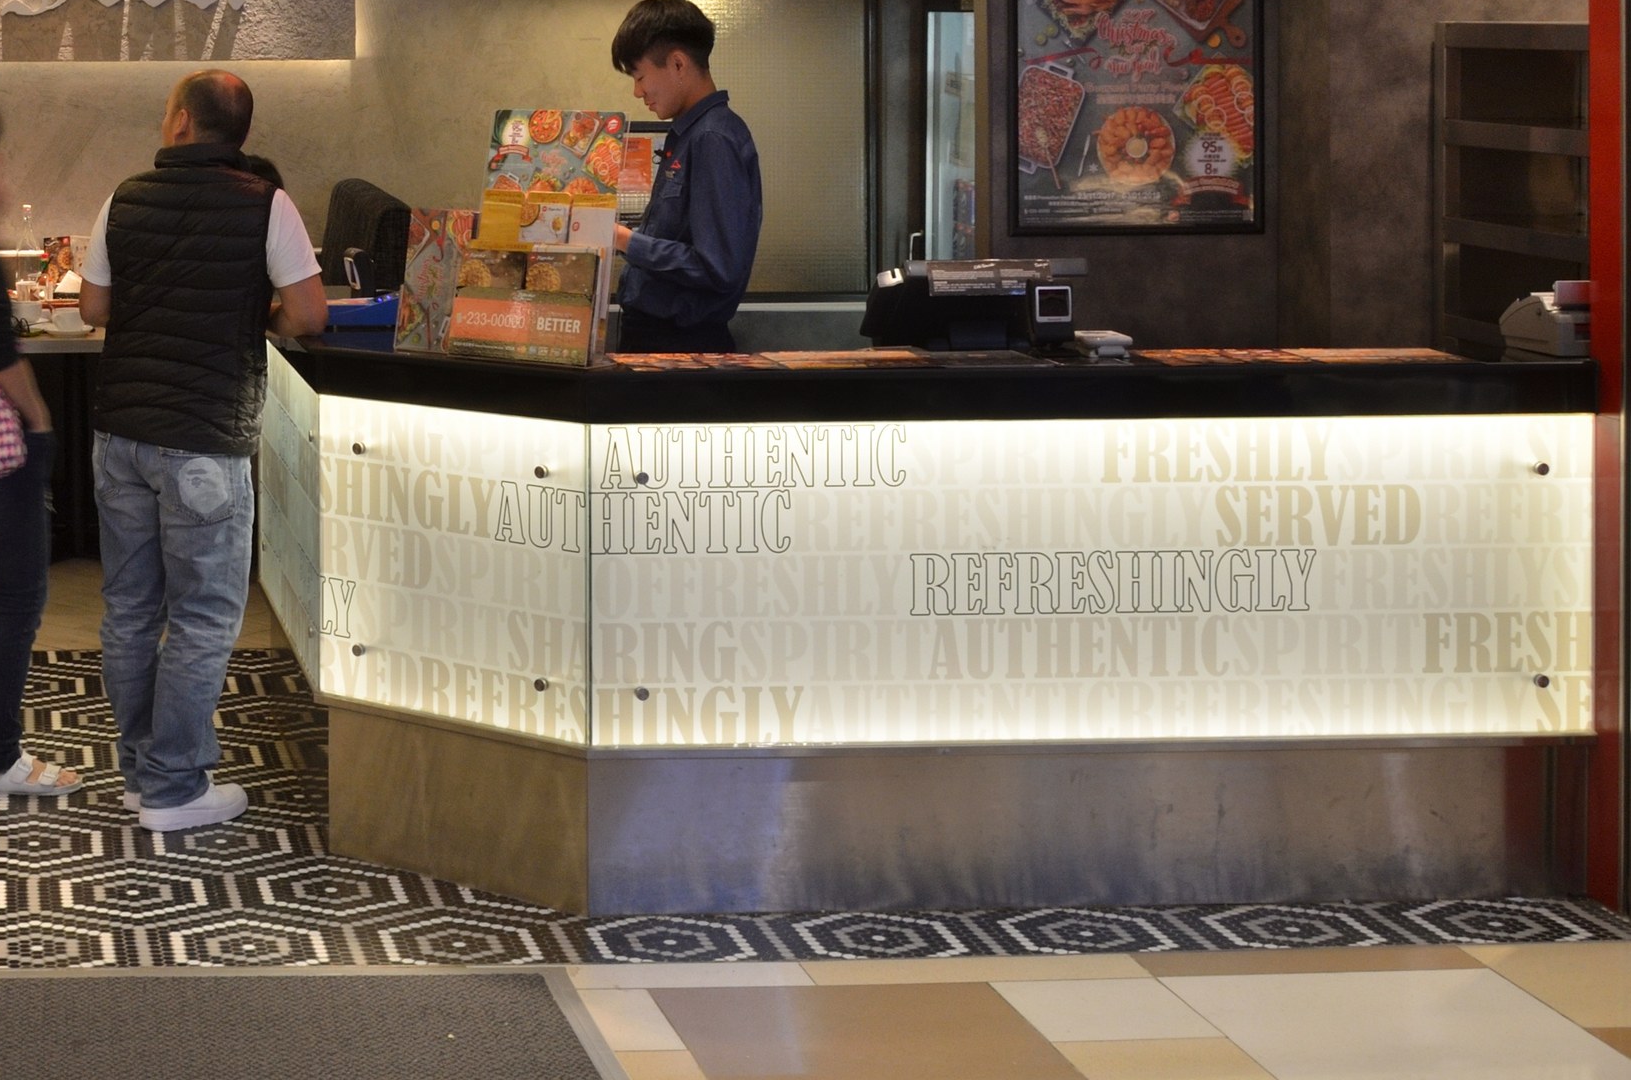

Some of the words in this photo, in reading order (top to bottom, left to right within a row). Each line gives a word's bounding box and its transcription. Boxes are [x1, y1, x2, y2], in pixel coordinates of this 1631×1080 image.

[536, 316, 582, 333] BETTER
[600, 423, 907, 489] AUTHENTIC
[1100, 422, 1333, 483] FRESHLY
[495, 479, 792, 555] AUTHENTIC
[793, 486, 1216, 552] REFRESHINGLY
[1214, 483, 1421, 547] SERVED
[910, 549, 1318, 616] REFRESHINGLY
[928, 613, 1231, 681] AUTHENTIC
